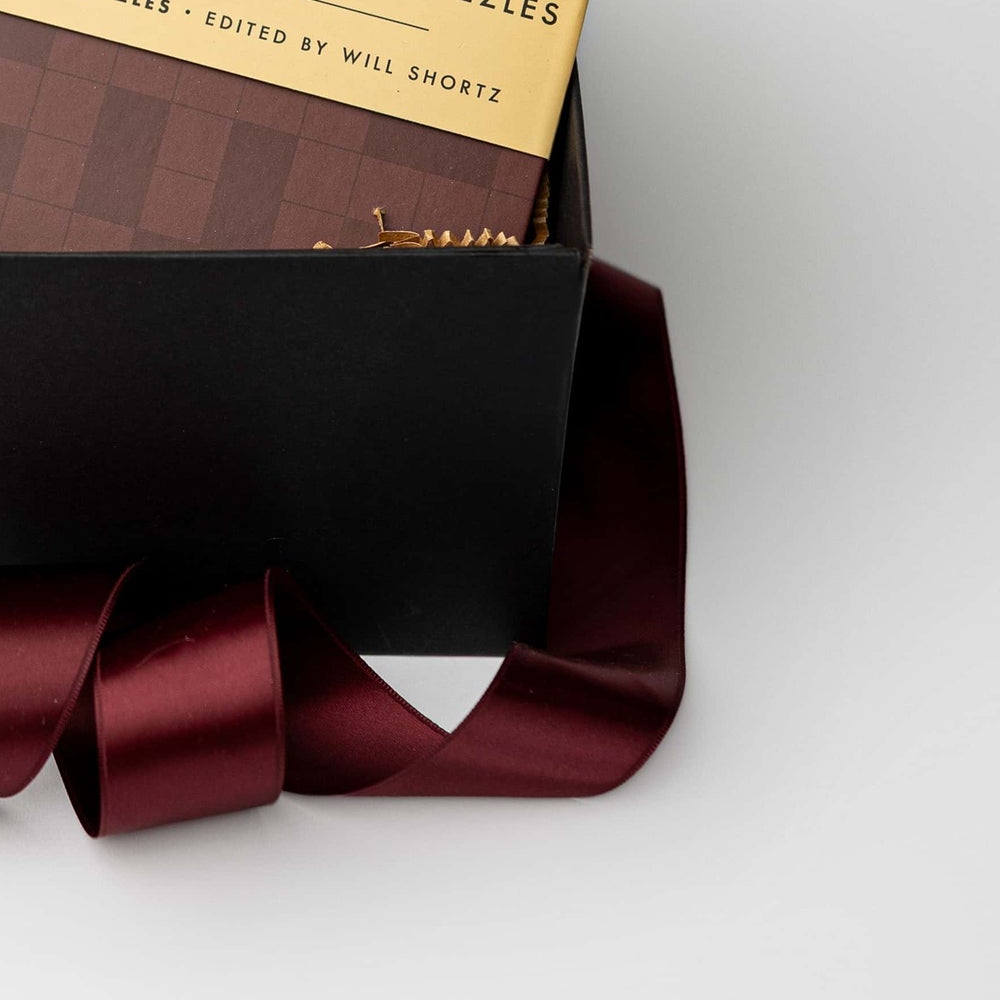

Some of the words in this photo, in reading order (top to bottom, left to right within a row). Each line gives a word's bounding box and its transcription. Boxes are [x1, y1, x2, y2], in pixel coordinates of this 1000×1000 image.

[205, 11, 286, 44] EDITED
[301, 37, 328, 55] BY
[343, 47, 394, 74] WILL
[408, 66, 501, 103] SHORTZ
